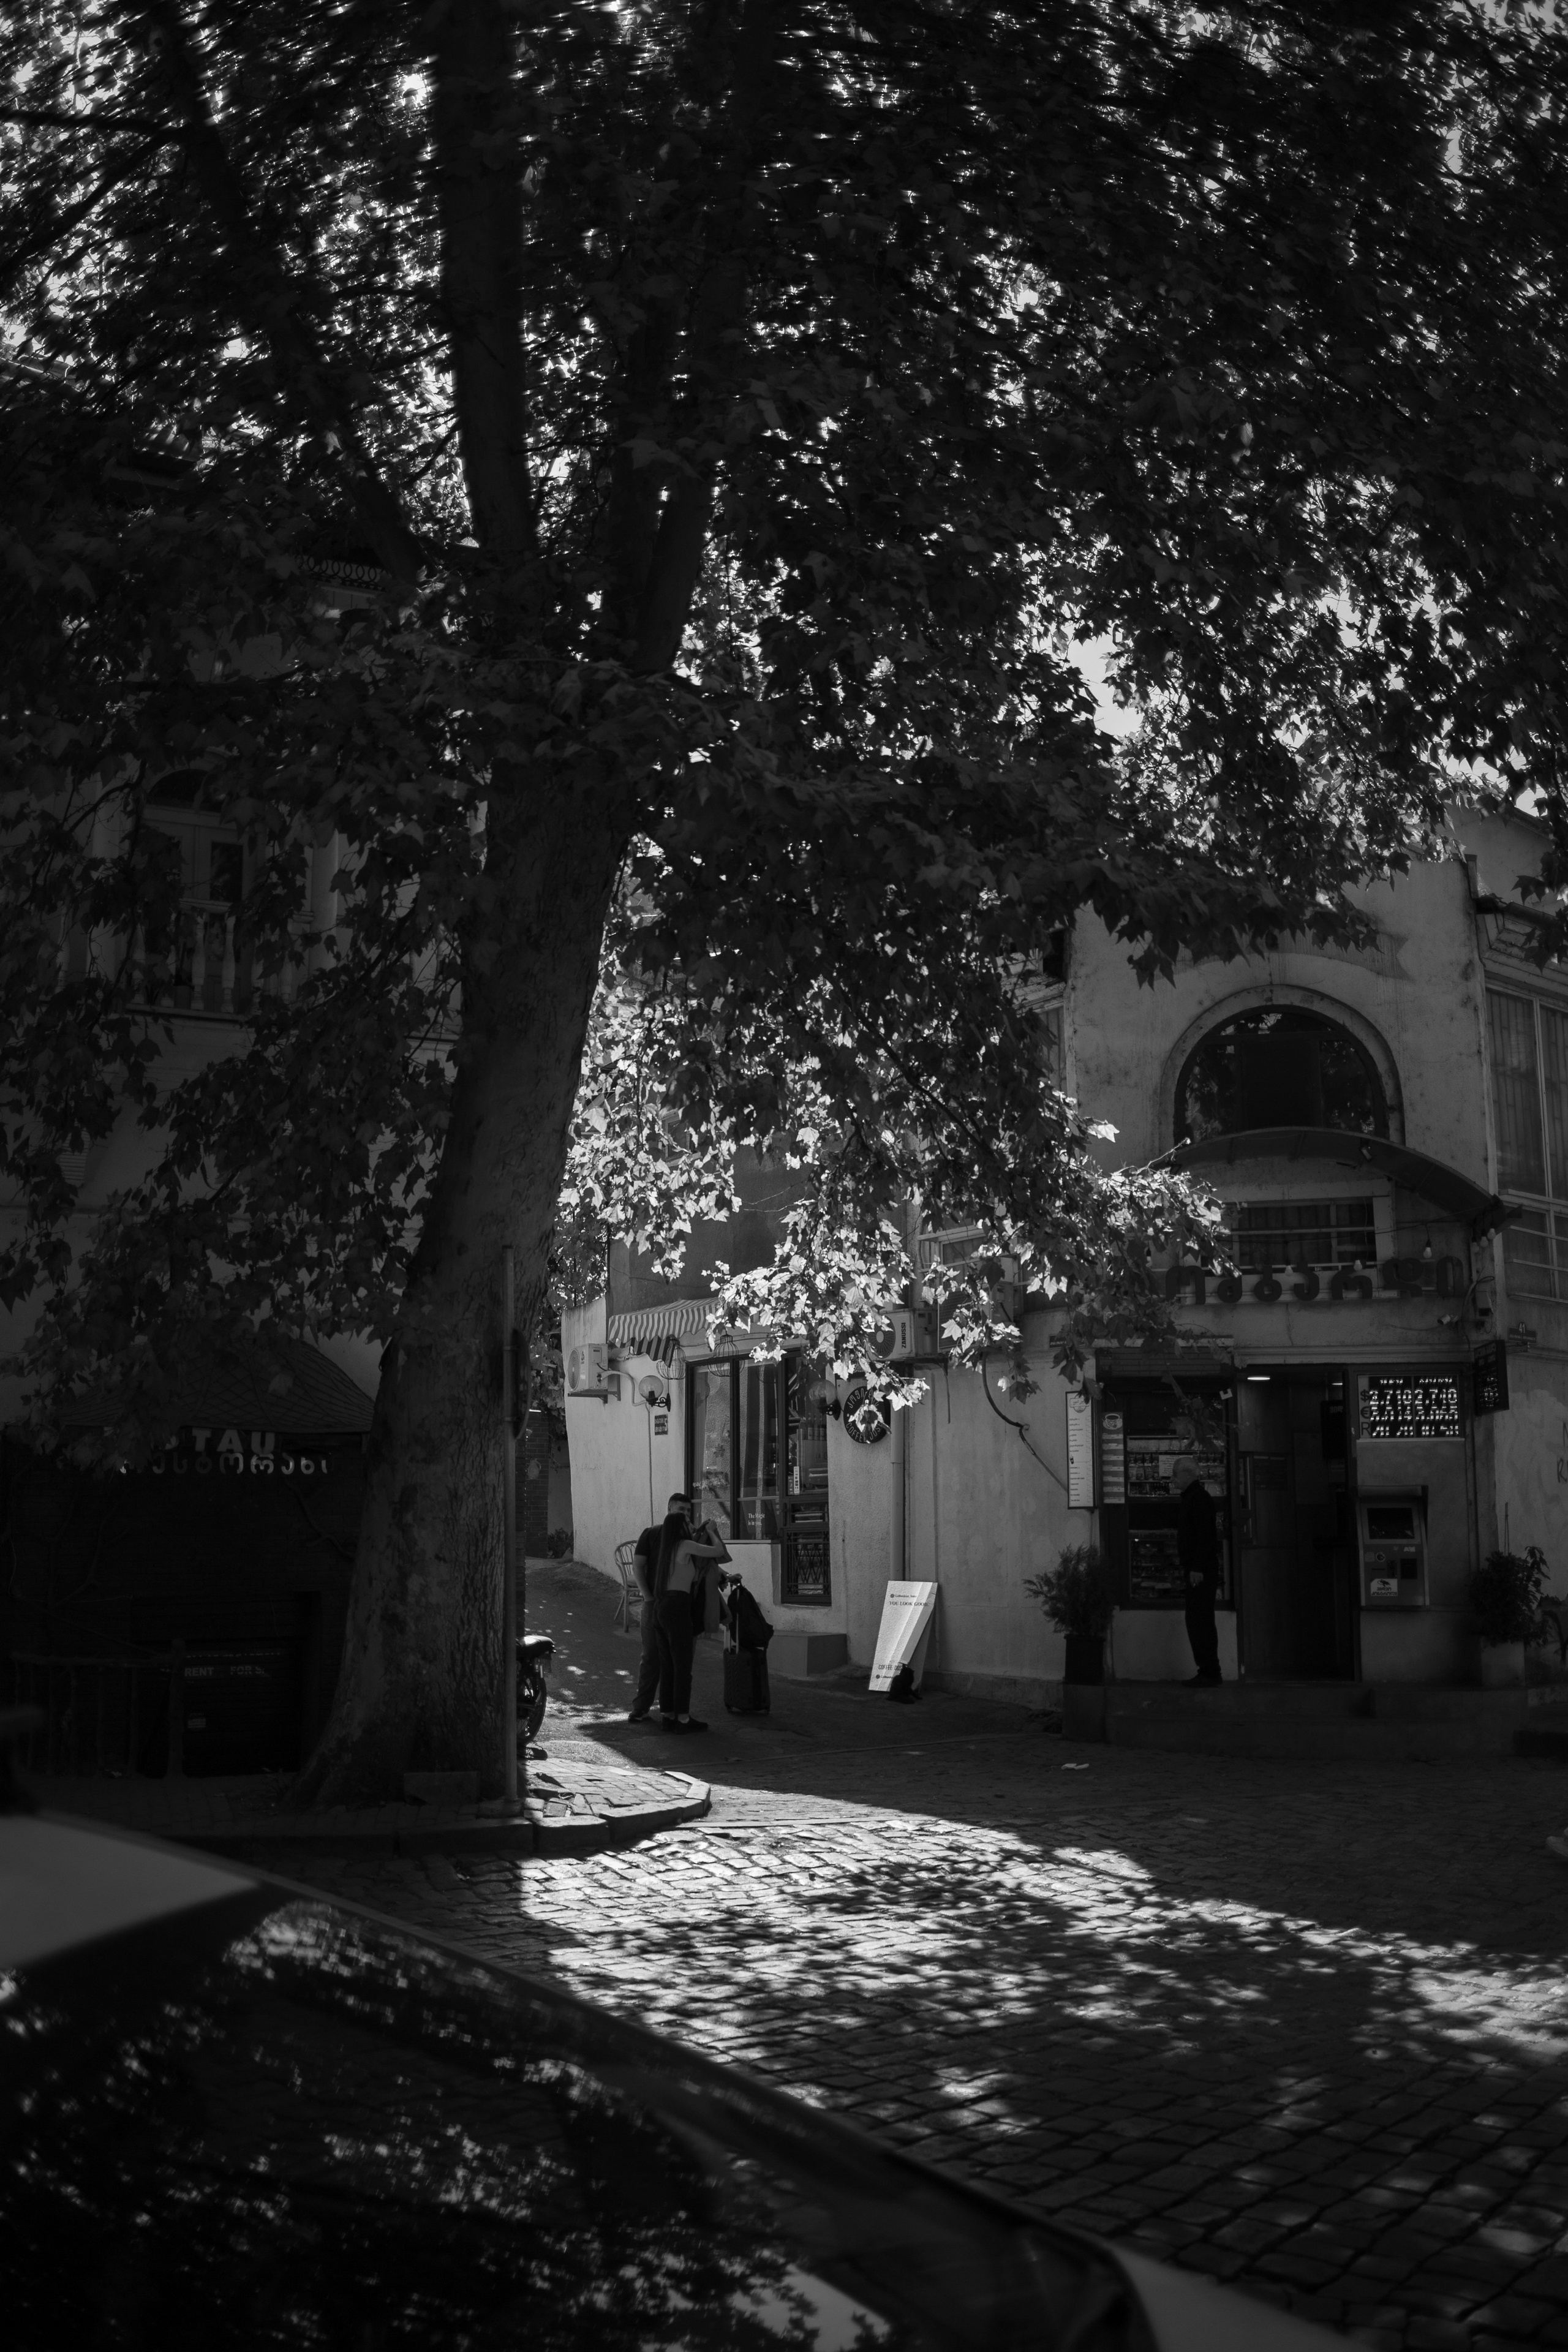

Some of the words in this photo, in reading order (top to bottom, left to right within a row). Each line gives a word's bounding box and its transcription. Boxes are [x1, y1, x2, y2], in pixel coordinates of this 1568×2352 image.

[1166, 1256, 1464, 1305] ომბარდი
[1518, 1322, 1526, 1333] 41
[184, 1667, 214, 1676] RENT
